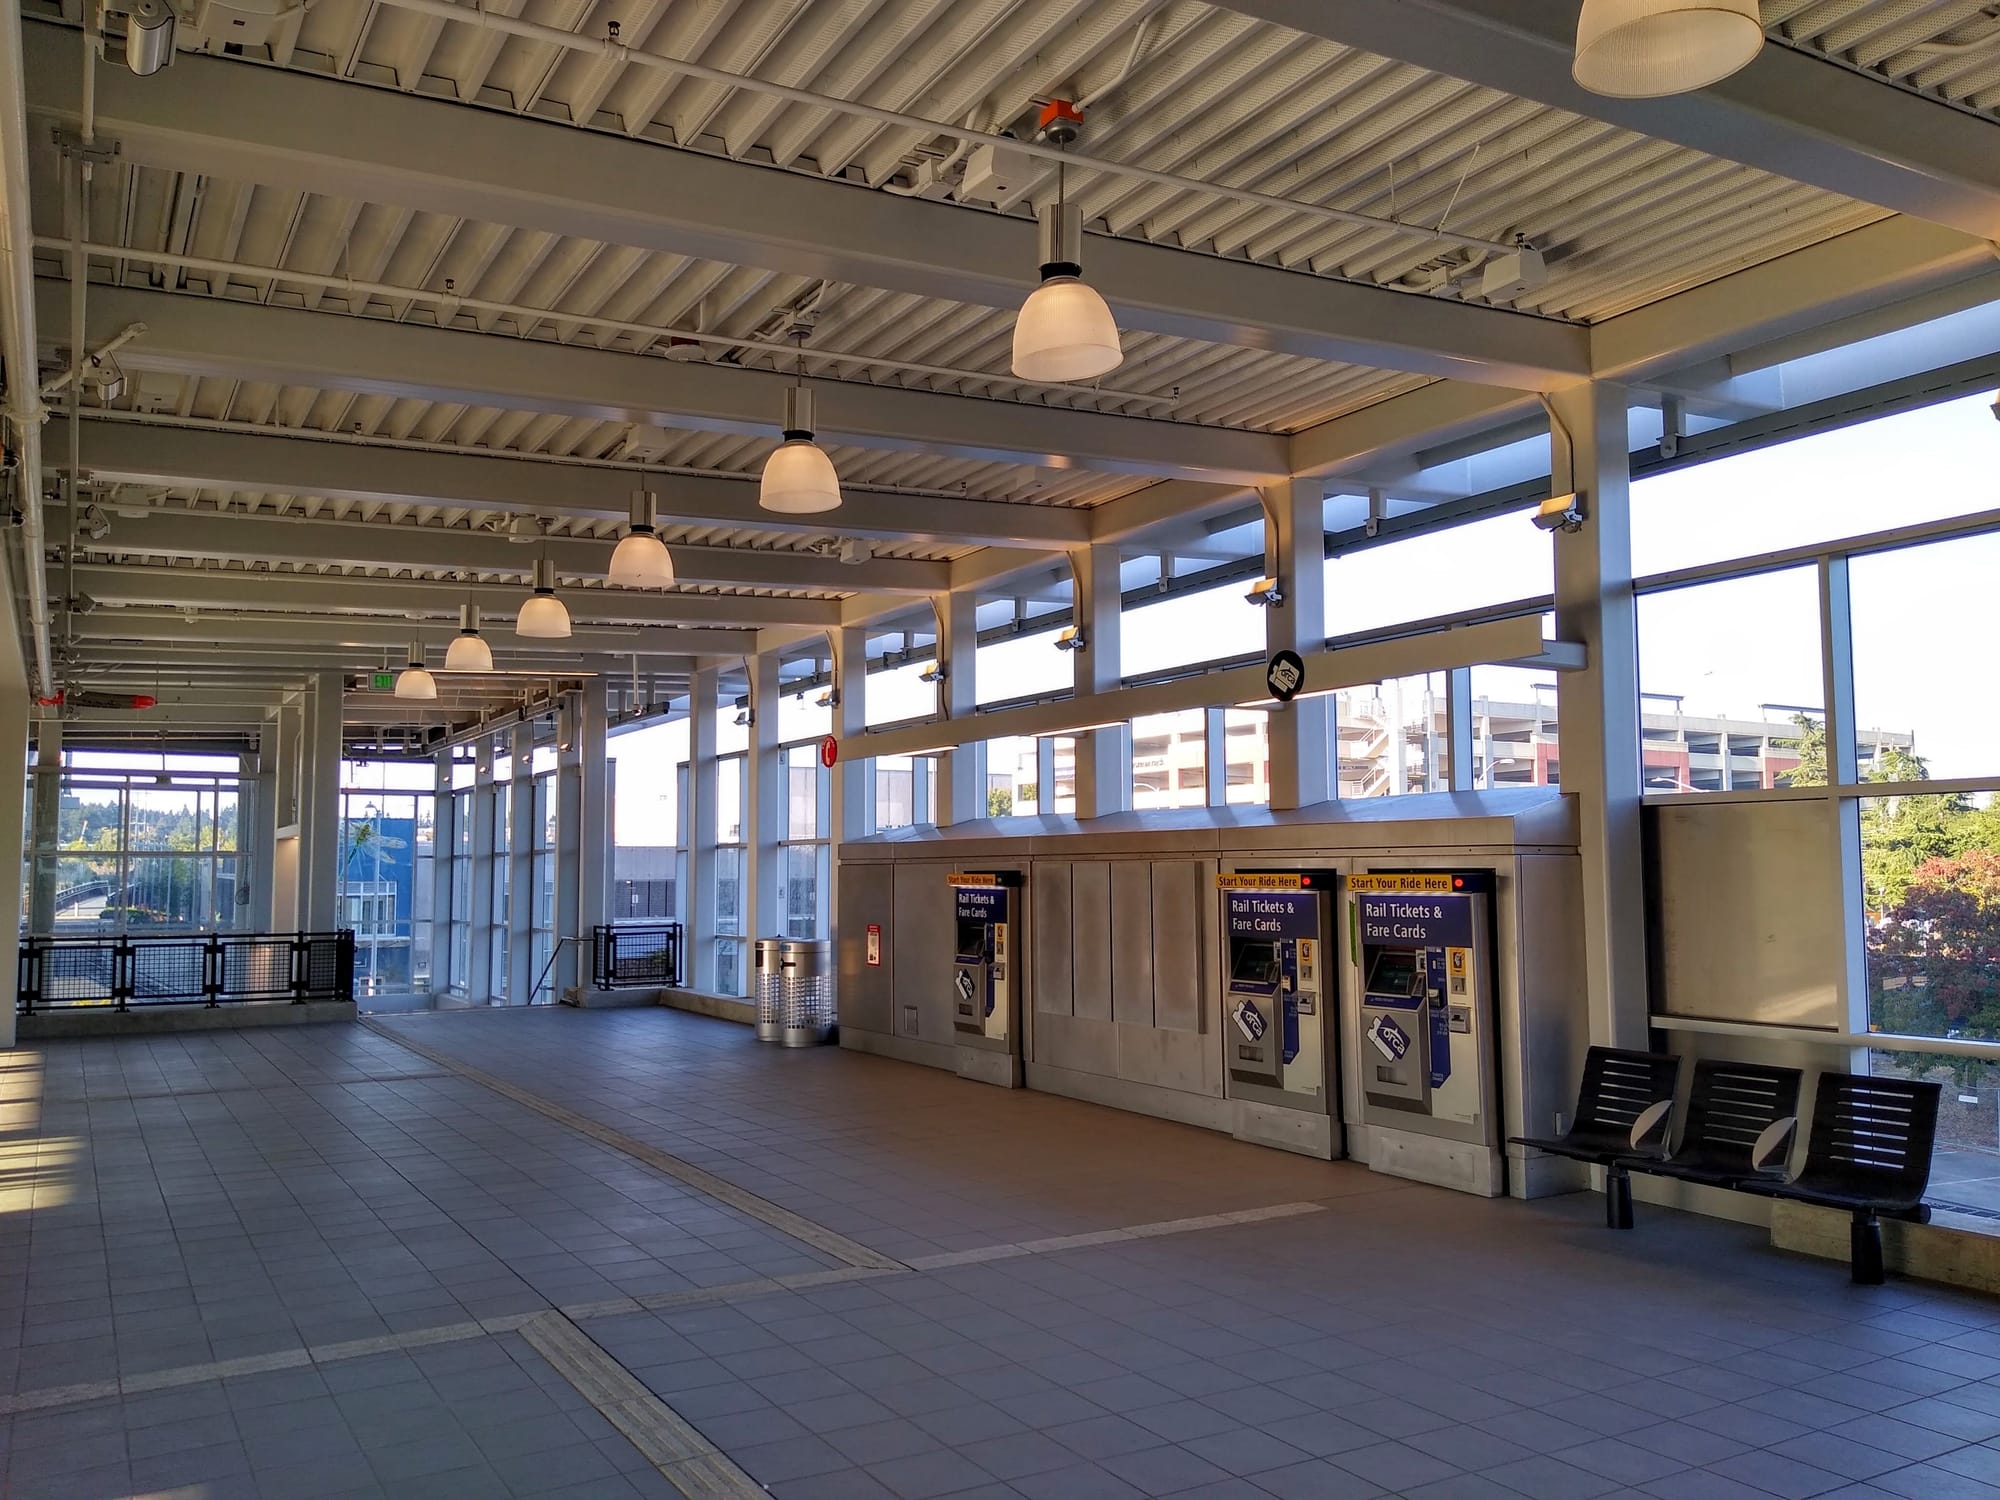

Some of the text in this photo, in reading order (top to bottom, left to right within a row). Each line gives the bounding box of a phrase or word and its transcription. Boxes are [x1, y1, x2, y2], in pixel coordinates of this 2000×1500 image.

[1280, 669, 1296, 685] orca
[1219, 876, 1297, 887] Start Your Ride Here
[1351, 877, 1448, 889] Start Your Ride Here
[958, 893, 969, 904] Rail
[970, 893, 989, 905] Tickets
[1232, 899, 1295, 914] Rail Tickets &
[958, 907, 987, 918] Fare Cards
[1366, 902, 1442, 919] Rail Tickets &
[1232, 918, 1281, 932] Fare Cards
[1366, 923, 1426, 939] Fare Cards
[1243, 1010, 1263, 1037] orca
[1382, 1028, 1405, 1055] orca
